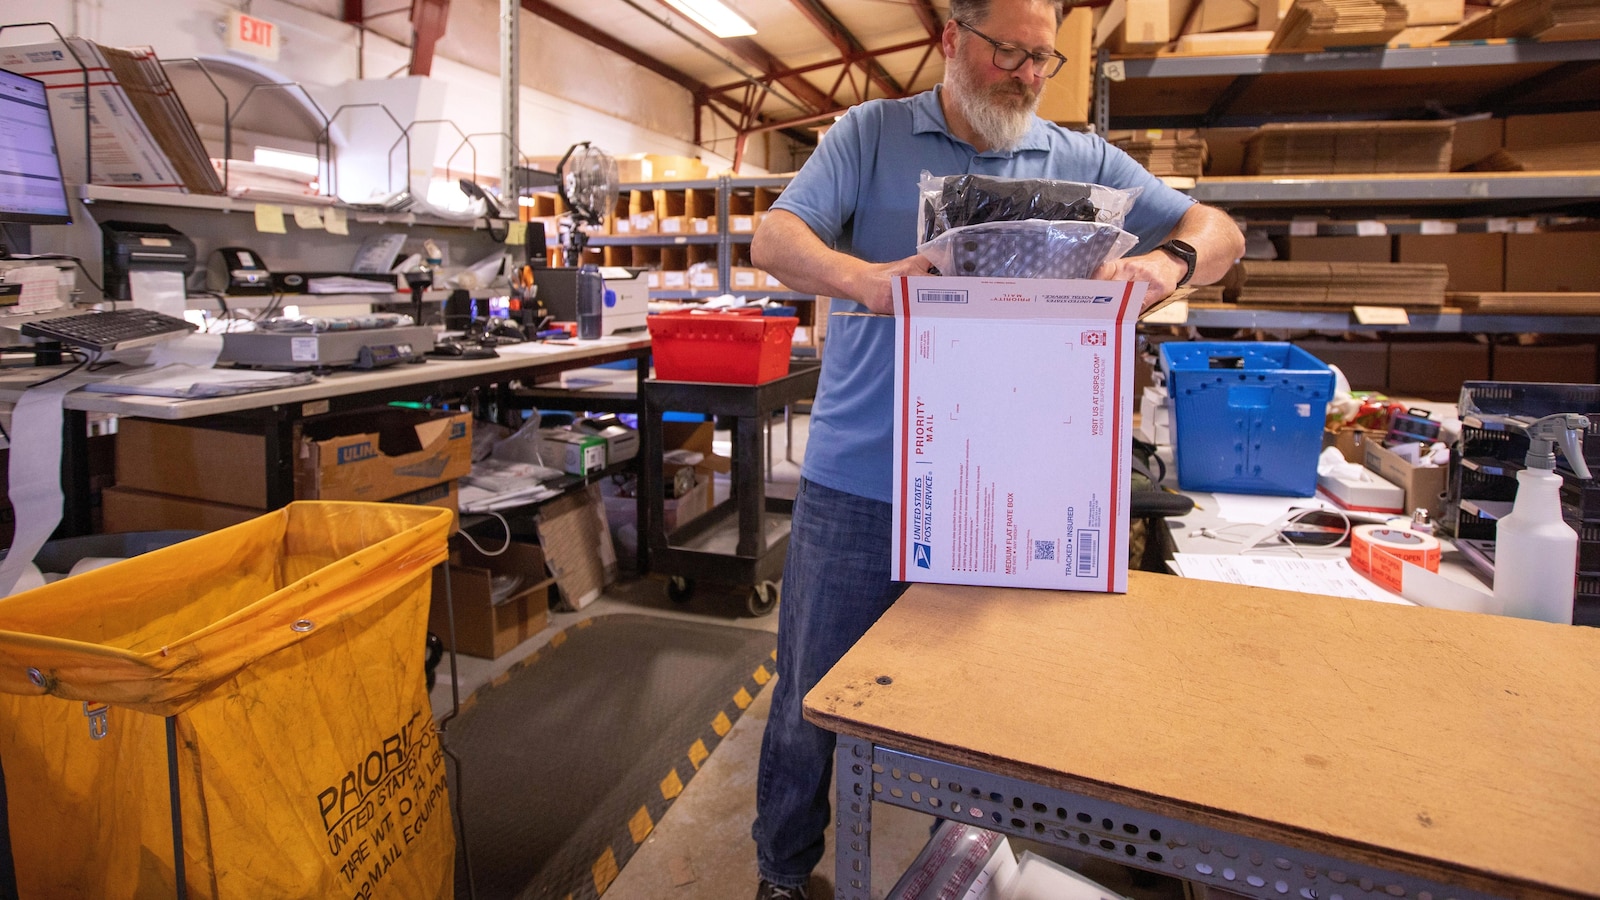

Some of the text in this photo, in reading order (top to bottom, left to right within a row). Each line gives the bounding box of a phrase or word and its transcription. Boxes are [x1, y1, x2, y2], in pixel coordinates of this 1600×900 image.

[240, 15, 273, 48] EXIT
[1092, 395, 1099, 405] AT
[1092, 406, 1099, 417] US
[926, 414, 934, 443] MAIL
[914, 477, 922, 541] UNITED STATES
[924, 512, 932, 543] POSTAL
[1065, 506, 1074, 577] TRACKED INSURED
[1403, 554, 1421, 562] OPEN
[328, 801, 374, 856] UNITED
[340, 839, 371, 883] TARE
[371, 811, 394, 847] WT.
